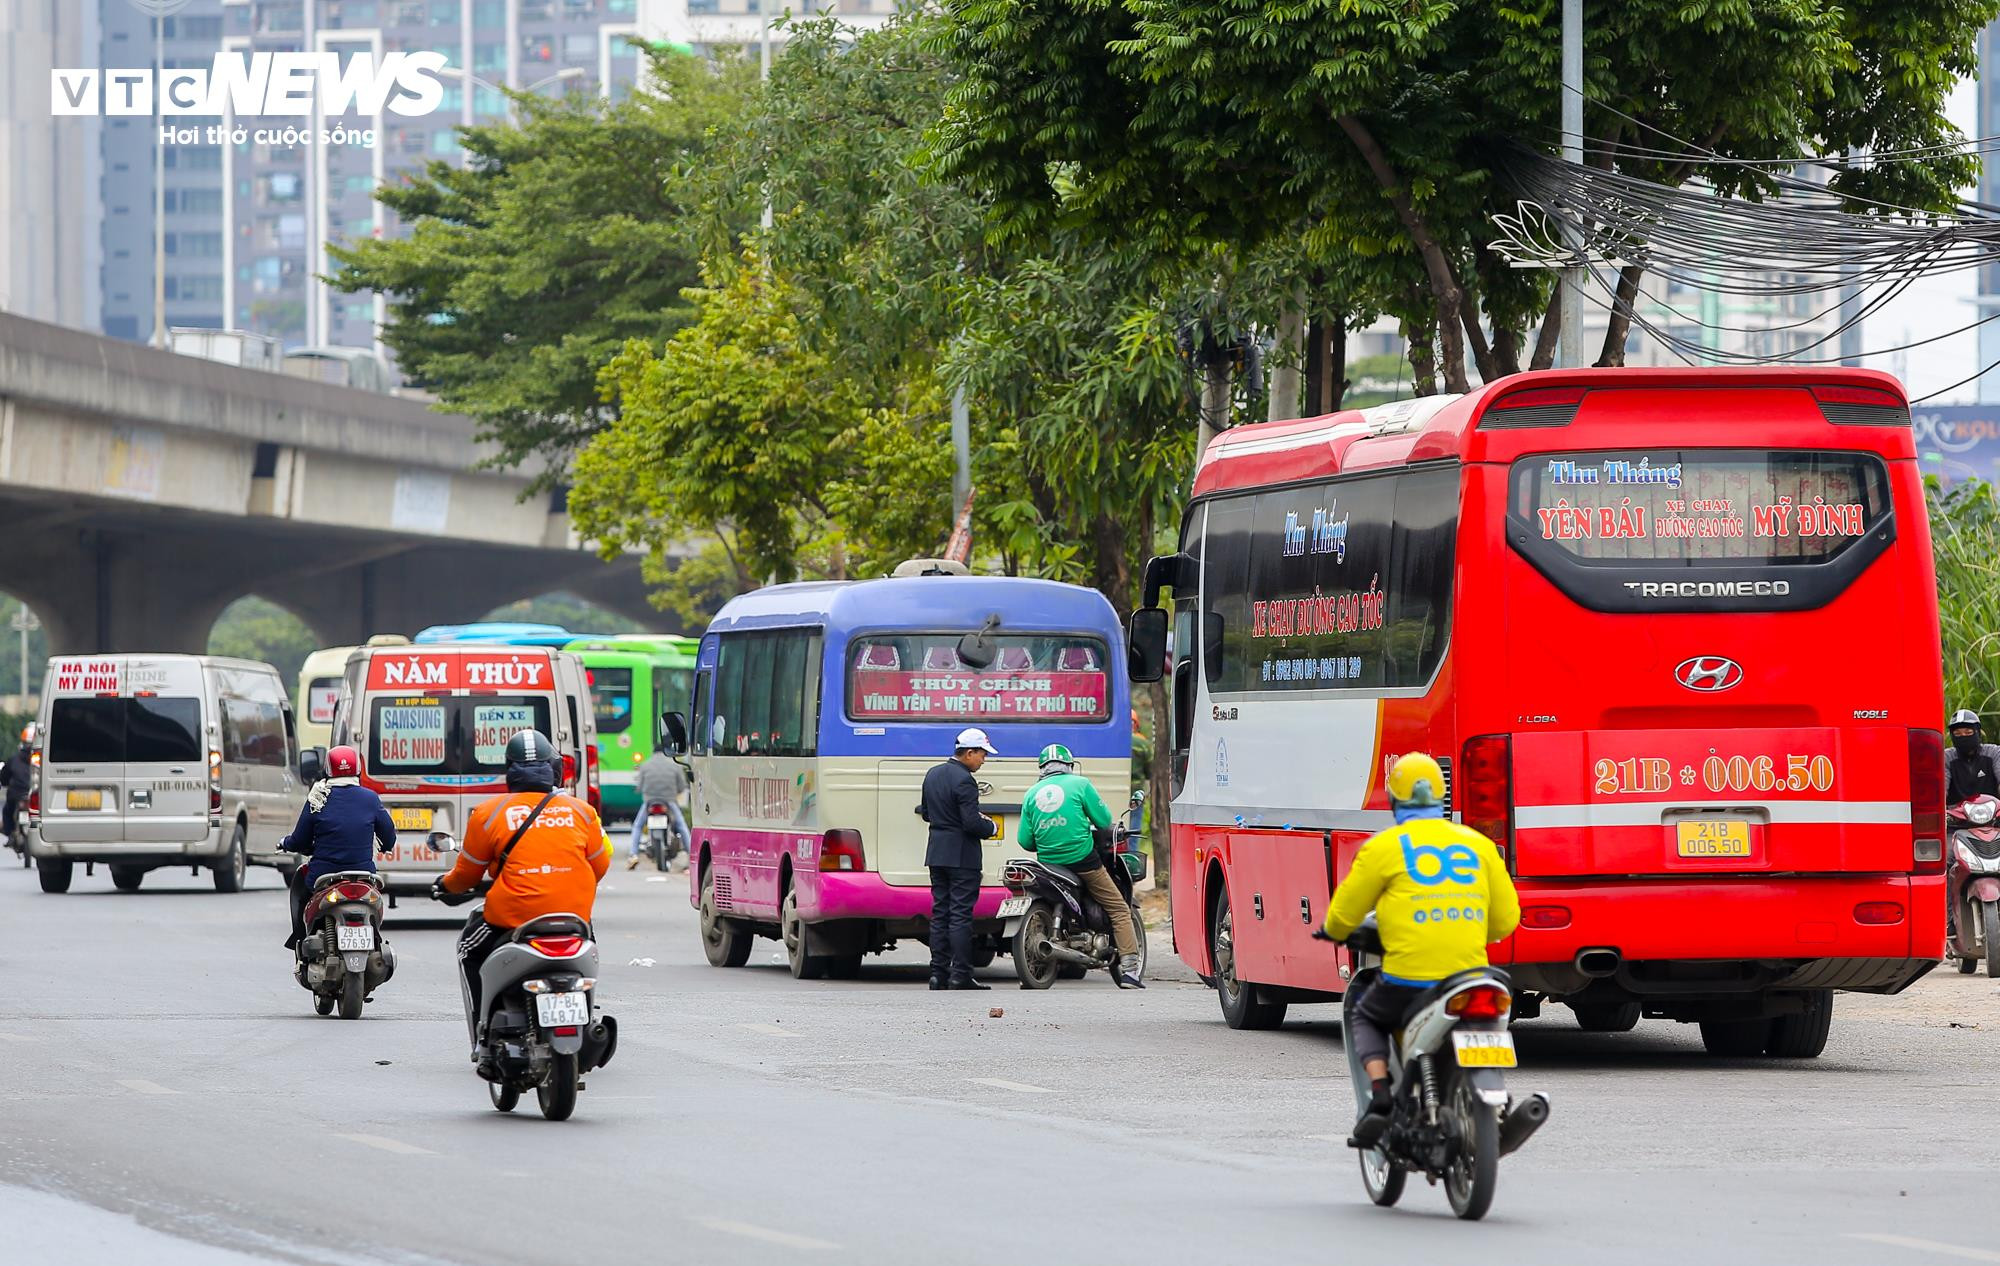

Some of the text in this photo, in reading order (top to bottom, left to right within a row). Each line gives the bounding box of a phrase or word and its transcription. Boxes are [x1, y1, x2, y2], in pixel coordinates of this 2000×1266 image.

[1548, 459, 1600, 485] Thu
[1537, 495, 1647, 539] YÊN BÁI
[1664, 499, 1733, 515] XE CHẠY
[1752, 495, 1866, 537] MỸ ĐÌNH
[1655, 511, 1745, 539] ĐƯỜNG CAO TỐC
[1623, 580, 1791, 597] TRACOMECO
[1252, 600, 1267, 639] XE
[1268, 599, 1298, 648] CHẠY
[1336, 593, 1360, 634] CAO
[384, 655, 543, 685] NĂM THỦY
[909, 673, 976, 691] THỦY
[901, 693, 931, 712] YÊN
[943, 693, 975, 715] VIỆT
[1015, 696, 1034, 712] TX
[1036, 693, 1066, 712] PHÚ
[1853, 709, 1889, 719] NOBLE
[384, 709, 441, 729] SAMSUNG
[508, 711, 526, 720] XE
[412, 738, 443, 760] NINH
[1594, 754, 1835, 795] 21B 006.50
[535, 814, 574, 828] Food
[1698, 823, 1729, 838] 21B
[1687, 839, 1742, 854] 006.50
[1398, 833, 1480, 886] be
[541, 1009, 585, 1024] 648.74
